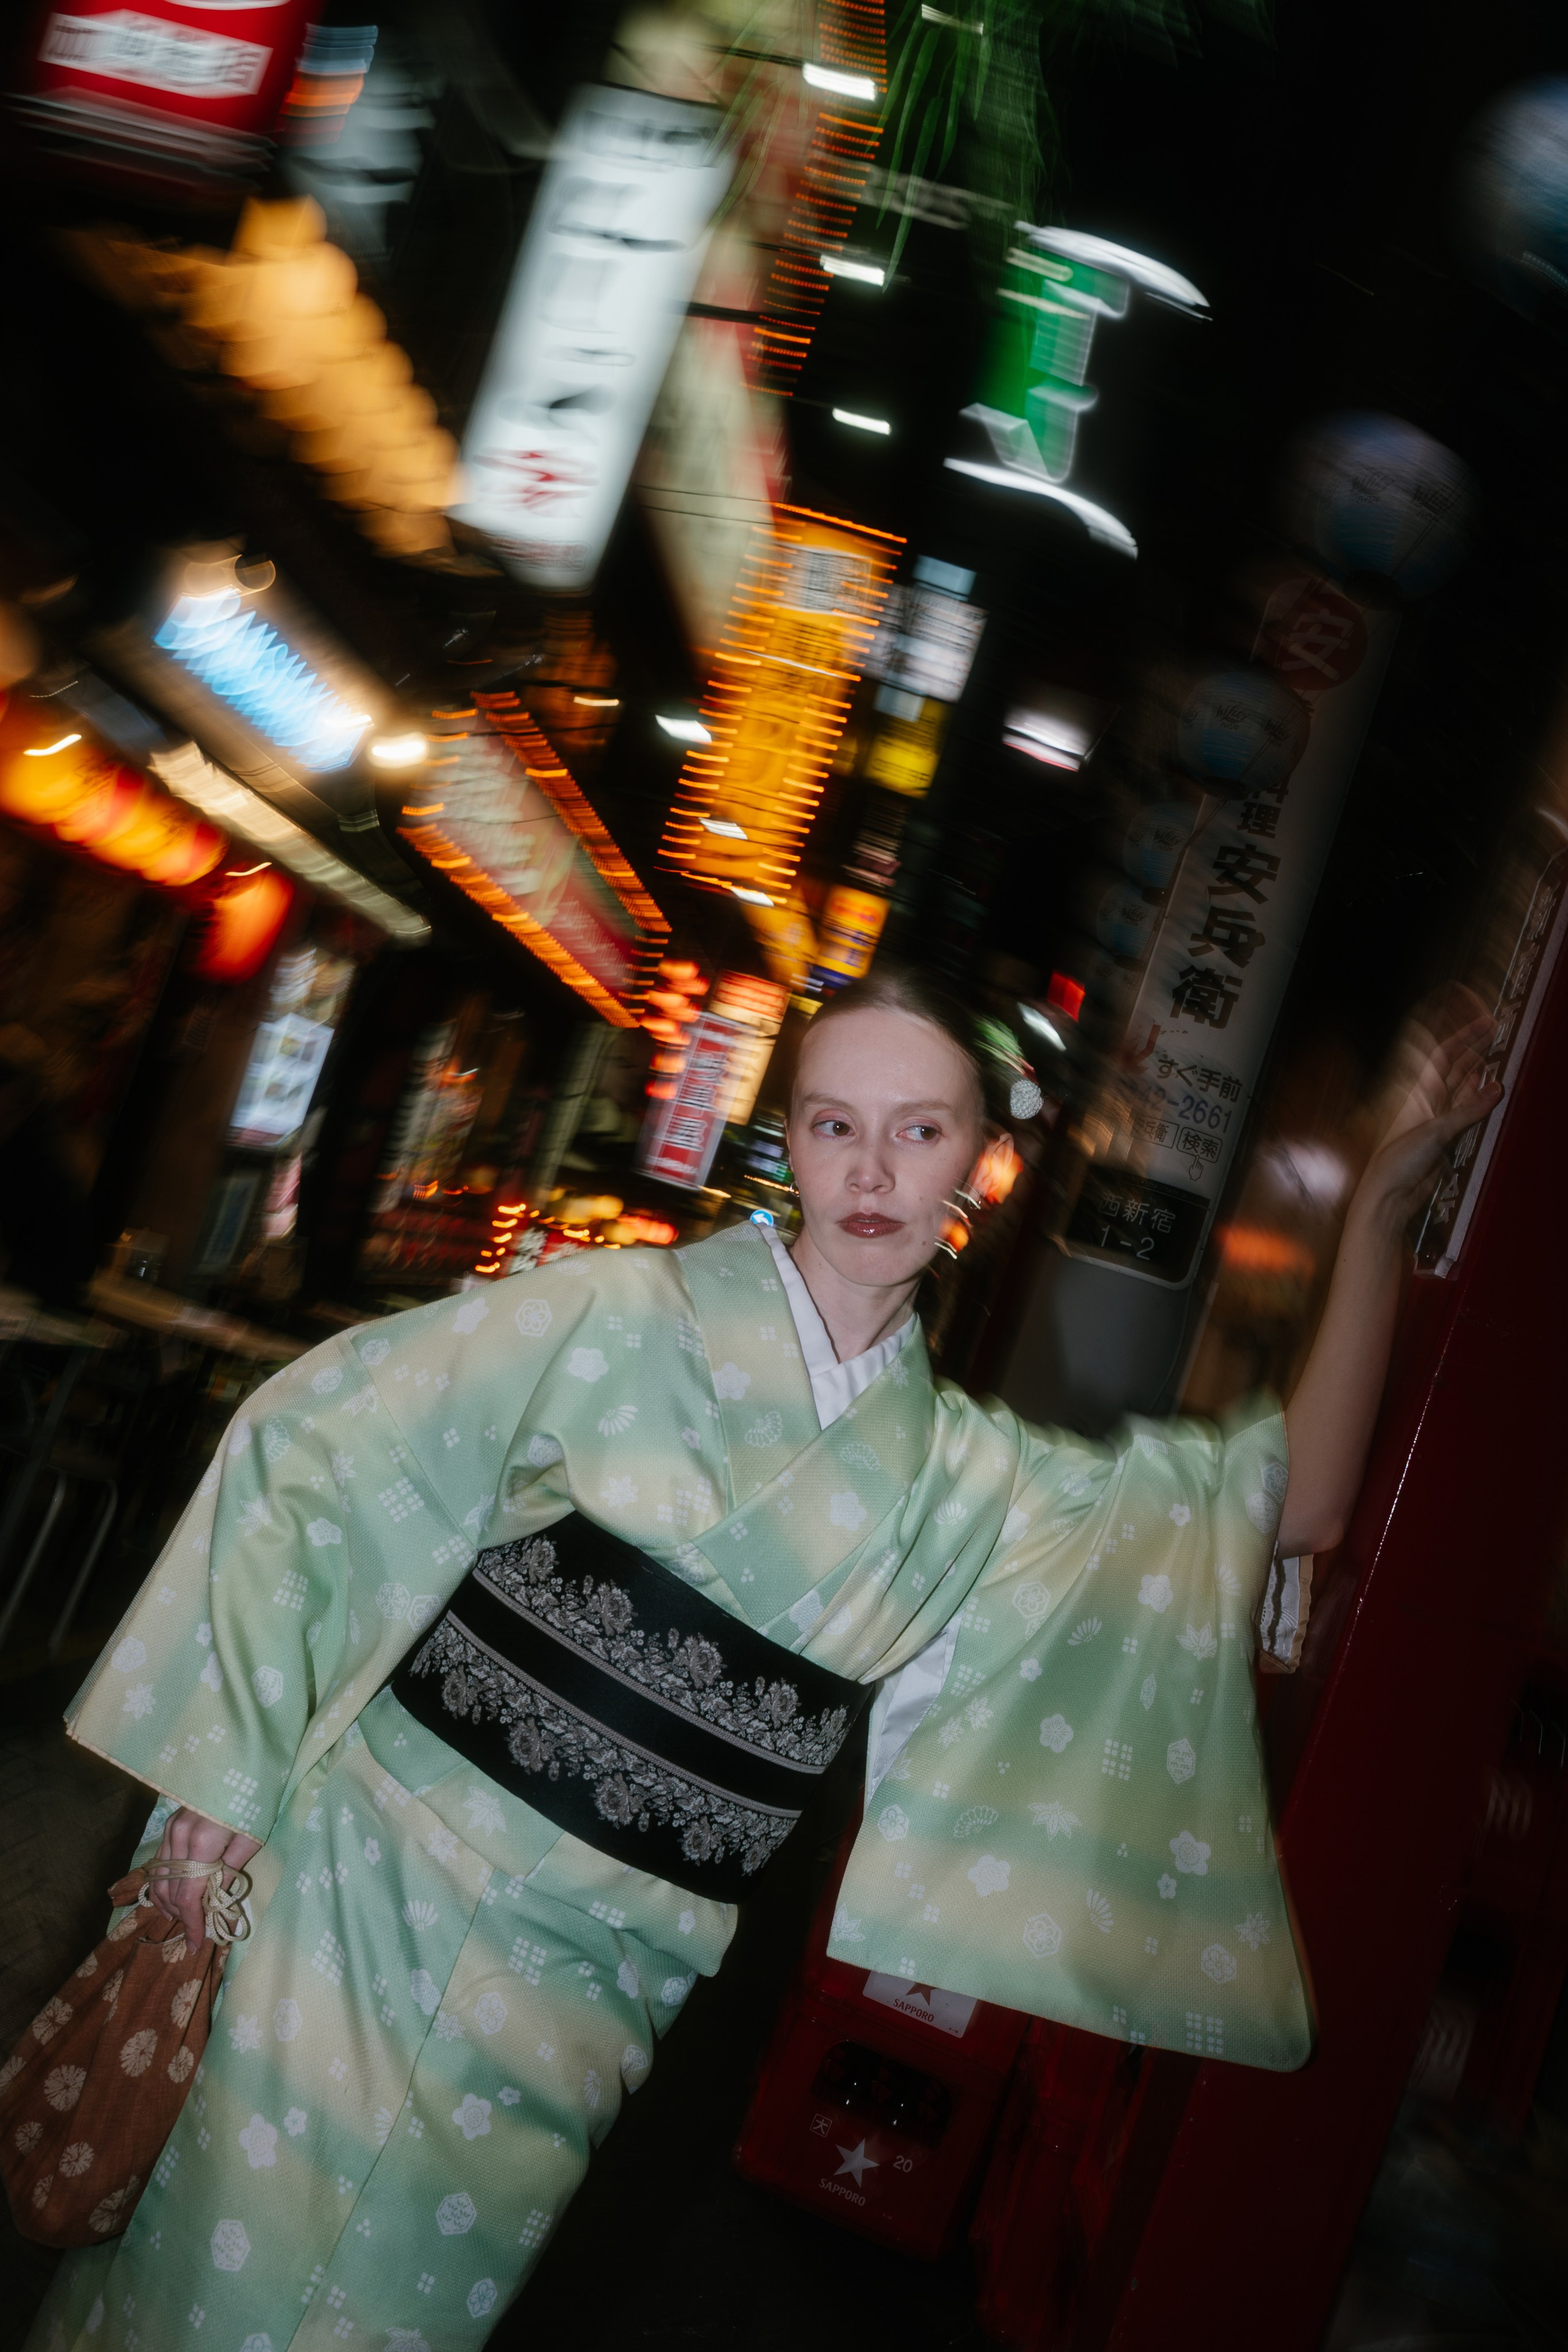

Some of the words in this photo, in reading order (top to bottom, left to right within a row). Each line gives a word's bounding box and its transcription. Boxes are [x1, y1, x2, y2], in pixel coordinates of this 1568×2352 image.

[1281, 608, 1355, 680] 安
[1157, 1058, 1243, 1103] すぐ手前
[1182, 1131, 1219, 1159] 検索
[1098, 1194, 1176, 1234] 西新宿
[893, 1998, 935, 2022] SAPPORO
[812, 2118, 829, 2135] 大
[892, 2155, 913, 2173] 20
[818, 2177, 866, 2206] SAPPORO
